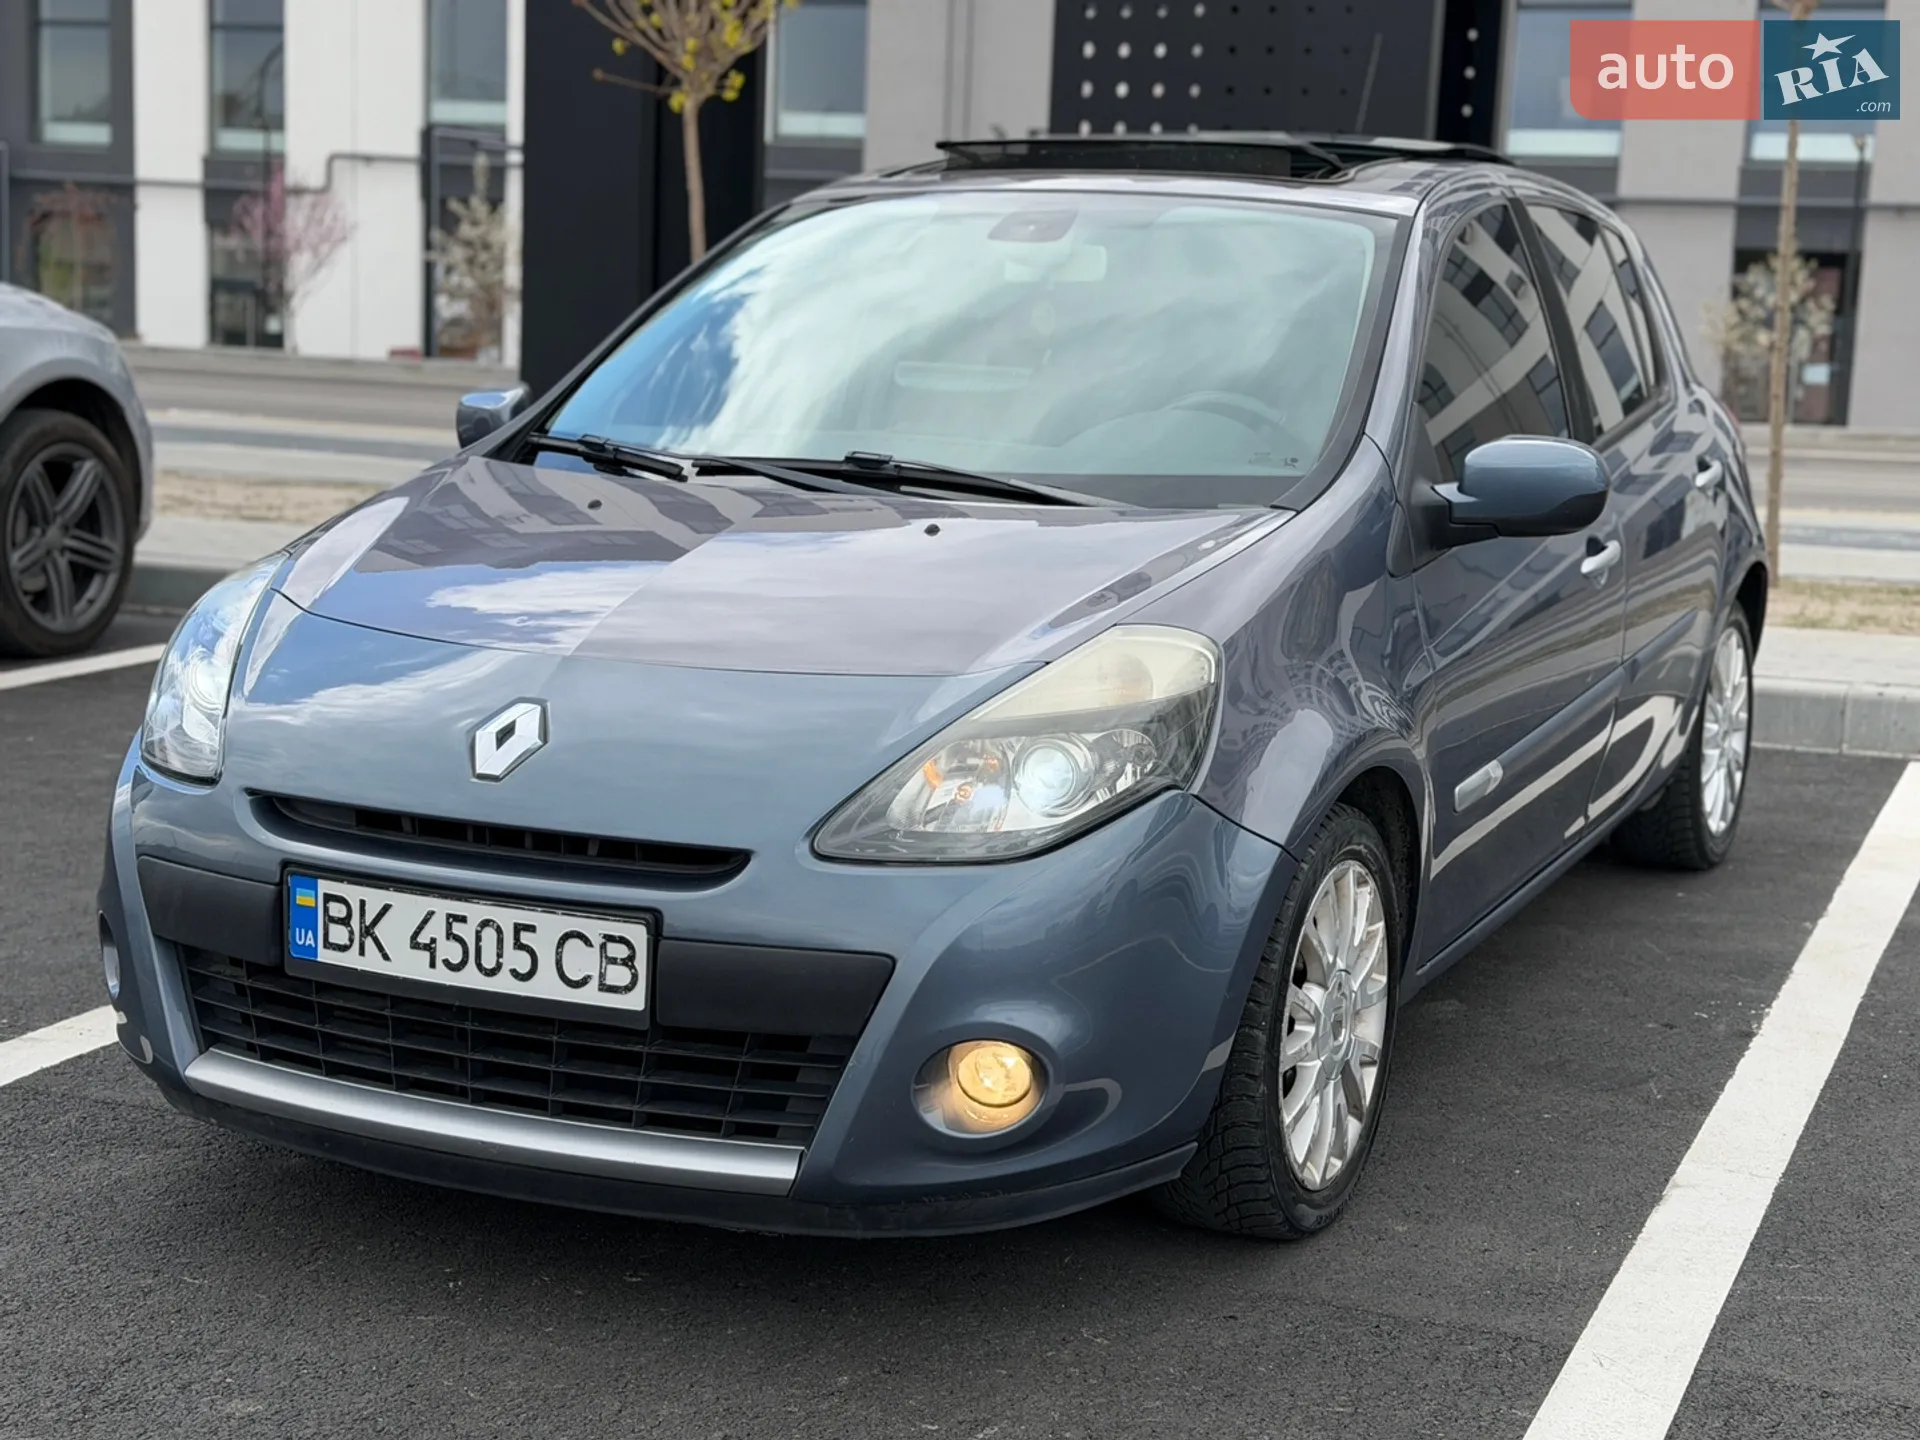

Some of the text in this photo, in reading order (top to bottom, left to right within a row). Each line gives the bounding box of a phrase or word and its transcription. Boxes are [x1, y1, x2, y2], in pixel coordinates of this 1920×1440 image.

[295, 927, 316, 948] UA
[322, 892, 640, 995] BK 4505 CB
